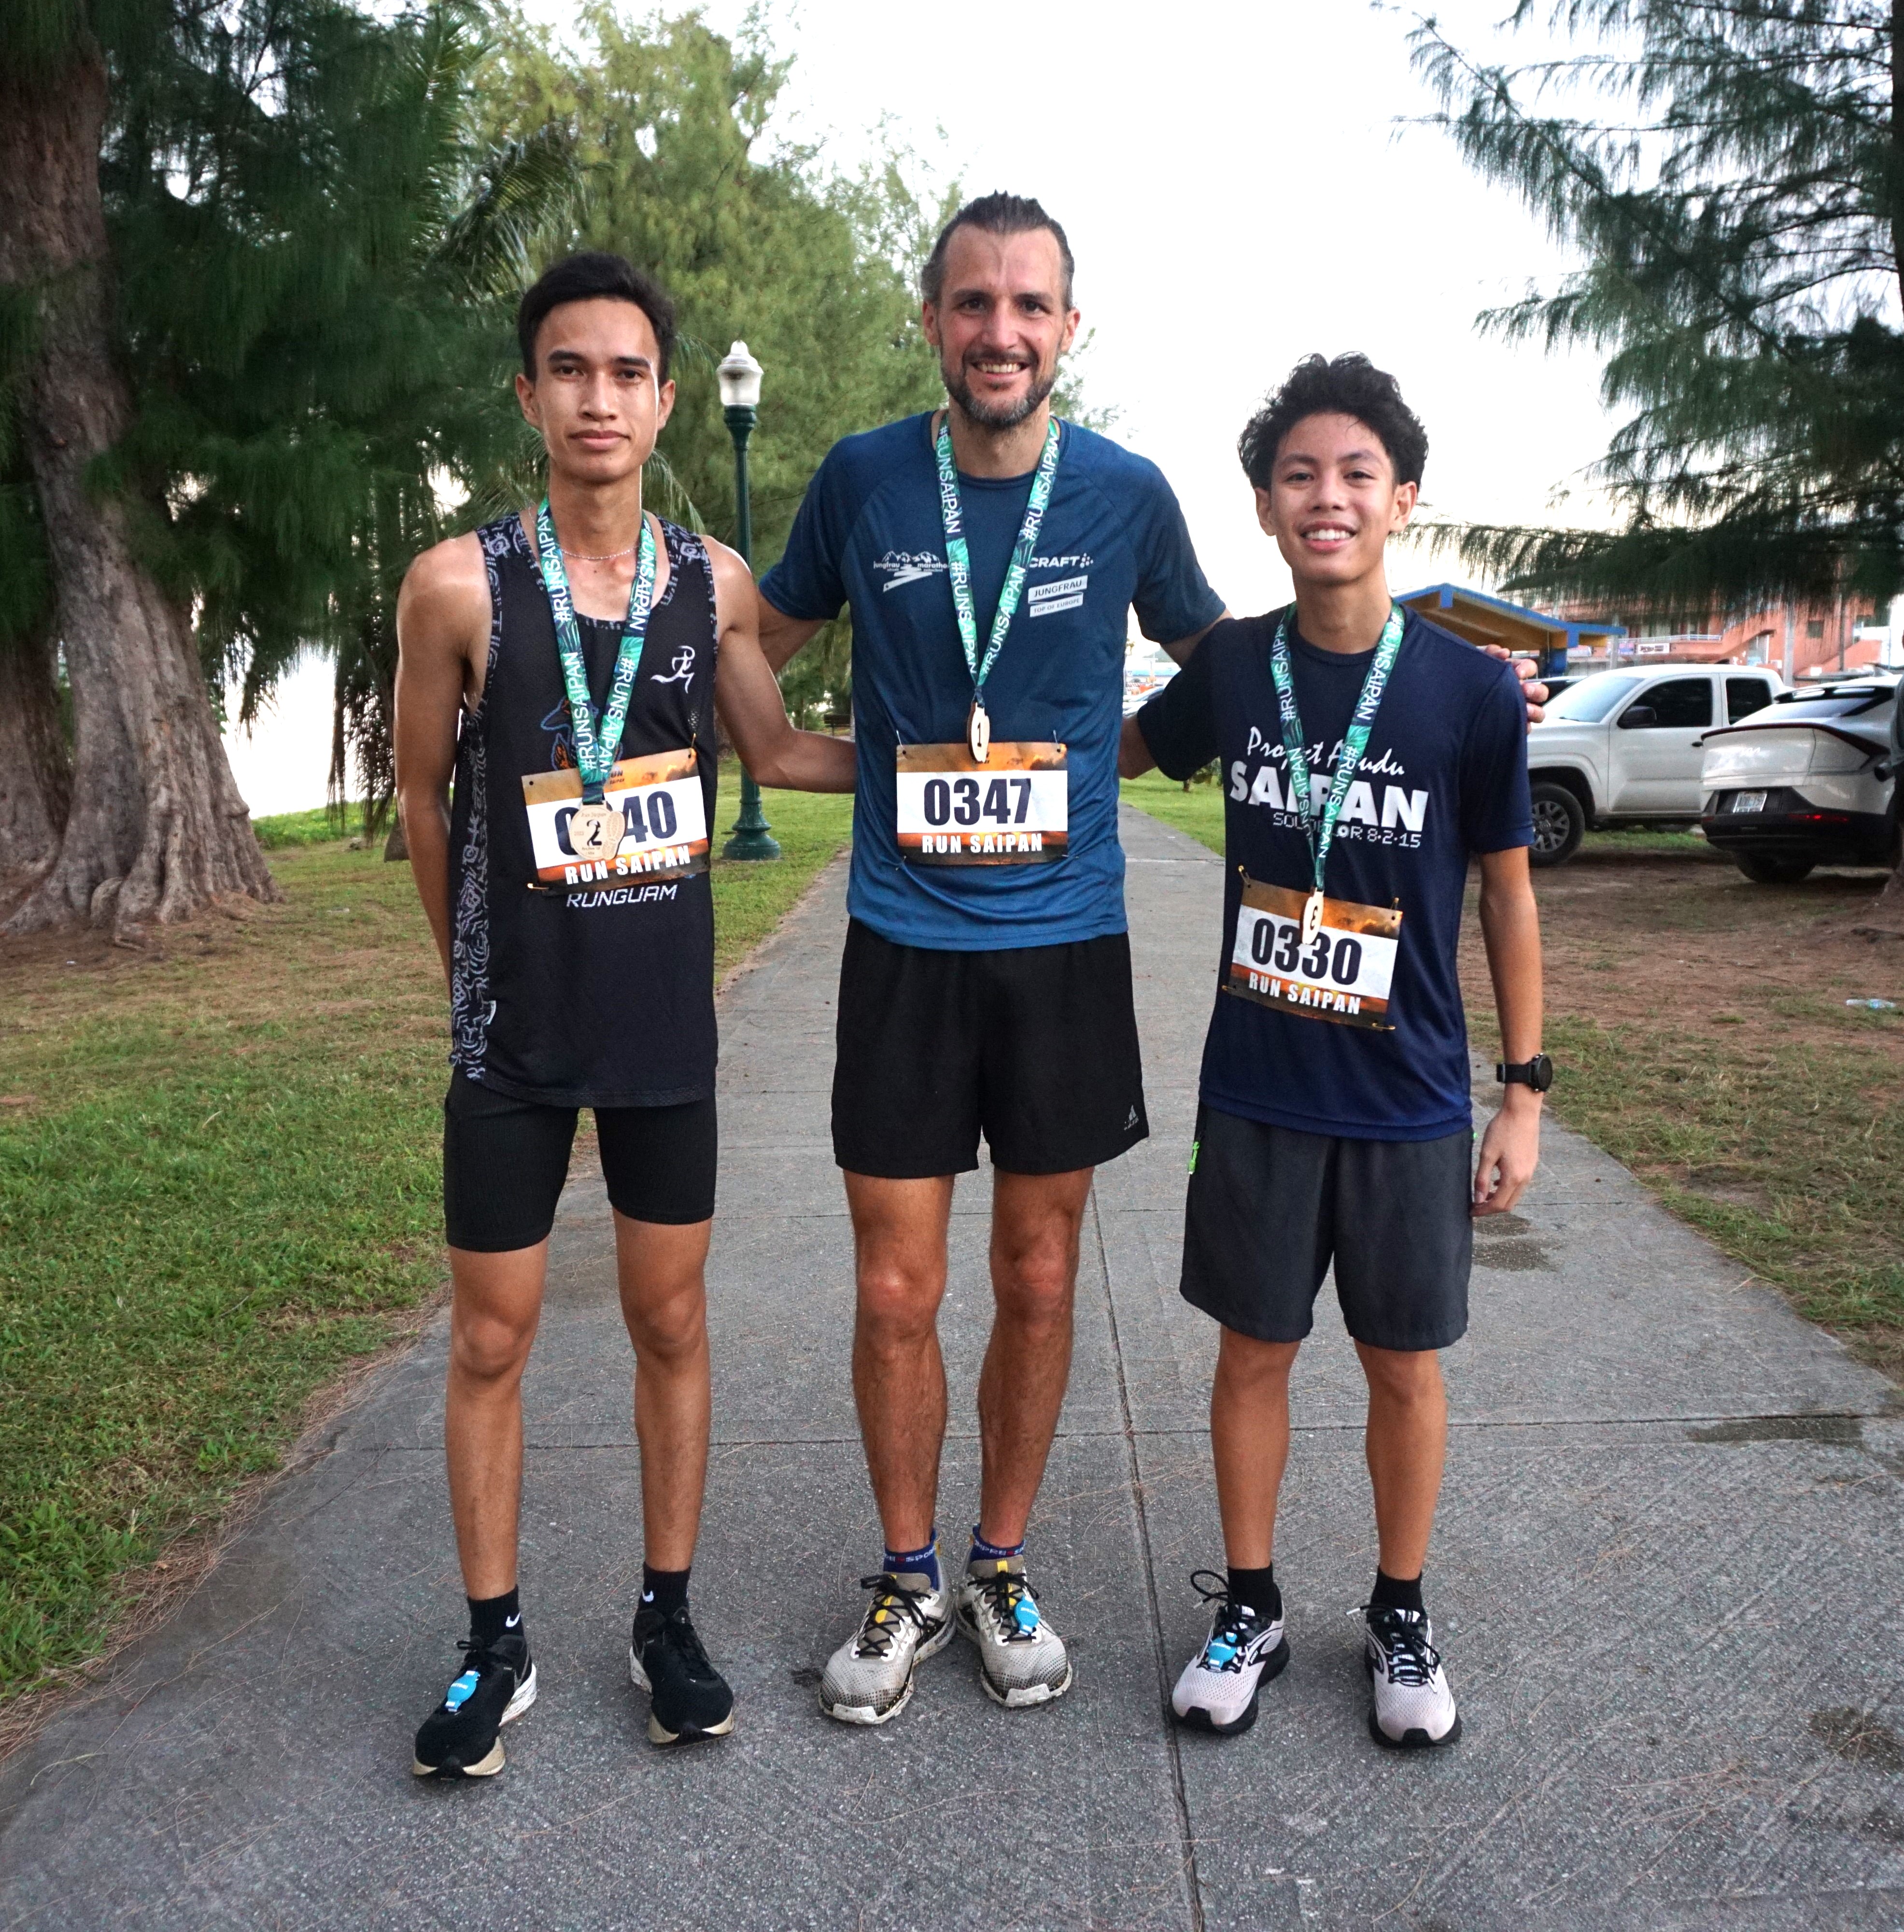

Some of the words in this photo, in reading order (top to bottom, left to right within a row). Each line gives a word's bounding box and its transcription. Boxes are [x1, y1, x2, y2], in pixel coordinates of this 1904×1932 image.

[937, 425, 961, 534] #RUNSAIPAN
[1024, 434, 1059, 541] #RUNSAIPAN
[537, 508, 572, 622] #RUNSAIPAN
[629, 519, 656, 631] #RUNSAIPAN
[1029, 556, 1080, 568] CRAFT
[1034, 580, 1082, 597] JUNGFRAU
[951, 561, 977, 674] #RUNSAIPAN
[982, 565, 1026, 674] #RUNSAIPAN
[1357, 612, 1401, 720] #RUNSAIPAN
[563, 652, 597, 770] #RUNSAIPAN
[599, 657, 635, 773] #RUNSAIPAN
[977, 722, 982, 747] 1
[555, 791, 677, 856] 040
[586, 819, 603, 846] 2
[924, 778, 1031, 826] 0347
[1317, 745, 1357, 858] #RUNSAIPAN
[564, 860, 608, 885] RUN
[615, 845, 691, 876] SAIPAN
[922, 835, 961, 853] RUN
[970, 833, 1042, 853] SAIPAN
[566, 884, 678, 908] RUNGUAM
[1252, 918, 1362, 986] 0330
[1249, 972, 1282, 997] RUN
[1287, 983, 1361, 1015] SAIPAN
